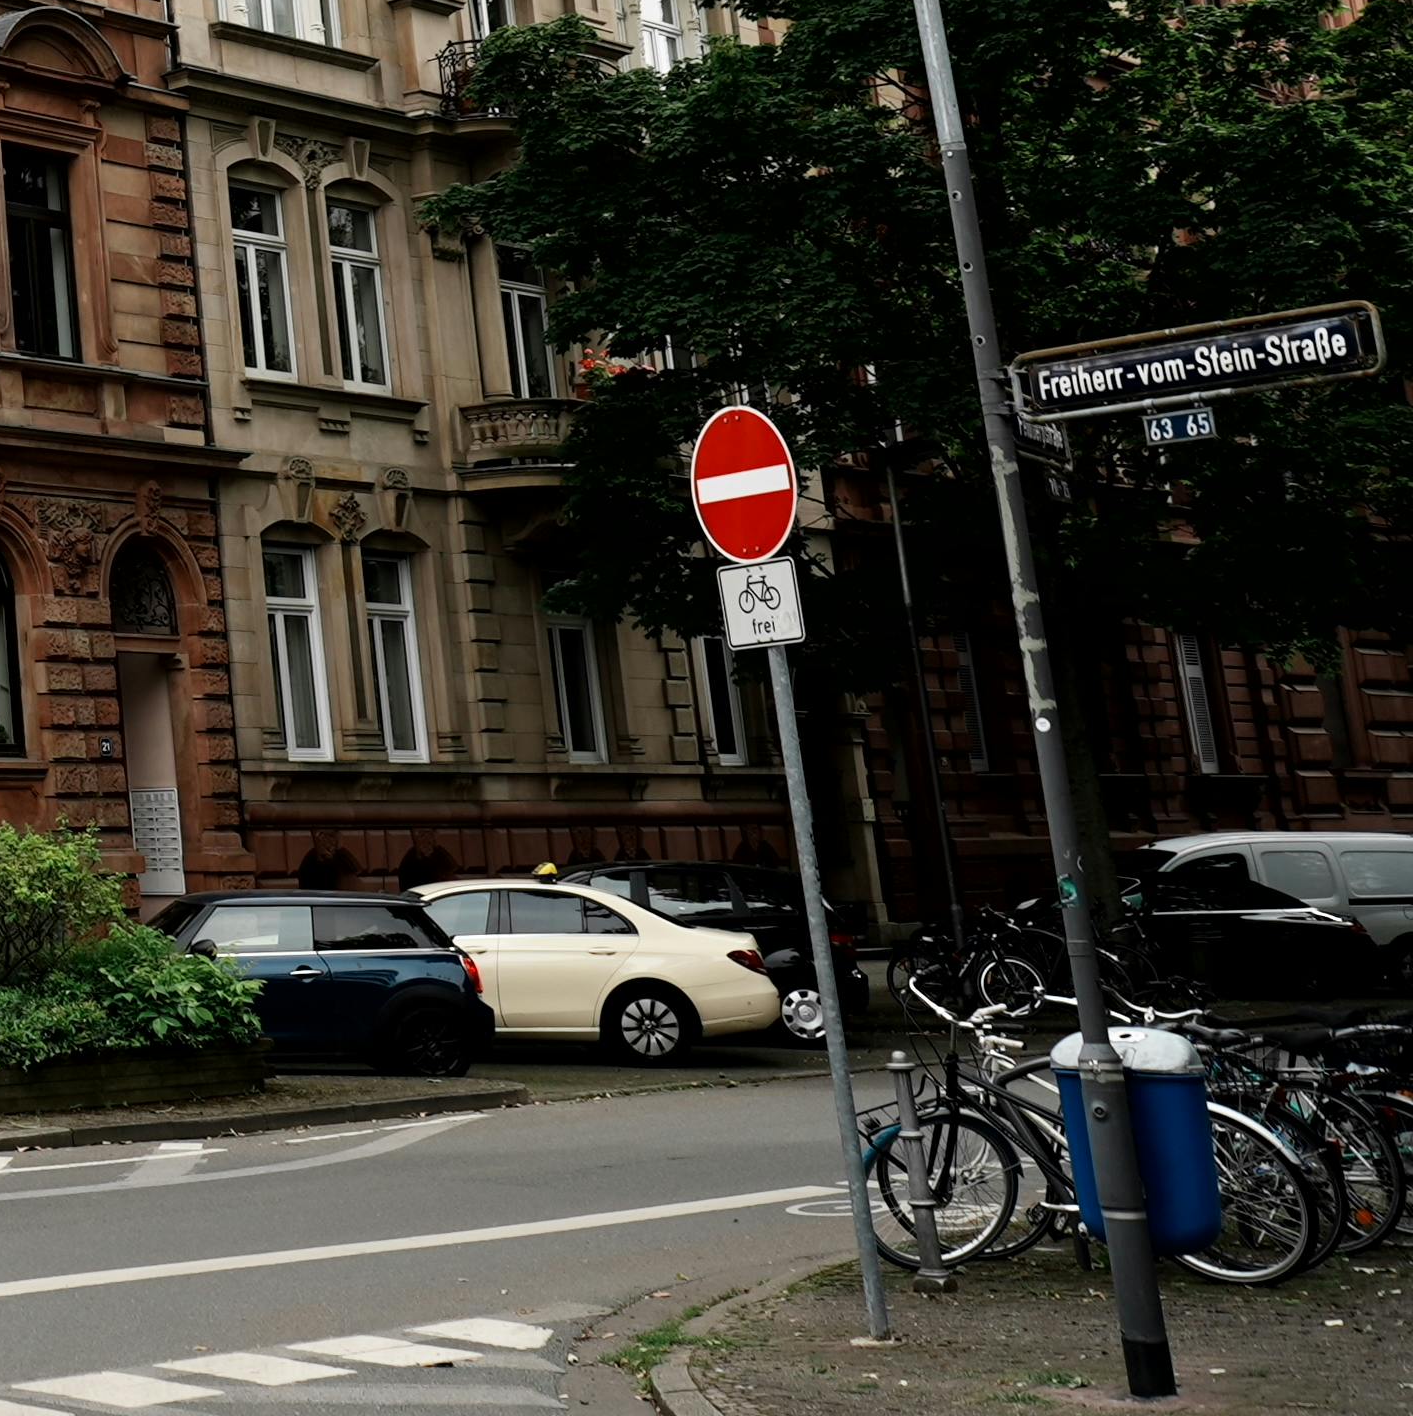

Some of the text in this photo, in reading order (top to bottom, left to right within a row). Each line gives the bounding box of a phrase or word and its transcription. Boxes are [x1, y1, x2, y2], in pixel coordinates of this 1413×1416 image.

[1037, 327, 1348, 401] Freiherr-vom-Stein-Straße
[1149, 413, 1210, 442] 63 65
[752, 616, 776, 635] frei
[101, 741, 111, 752] 21
